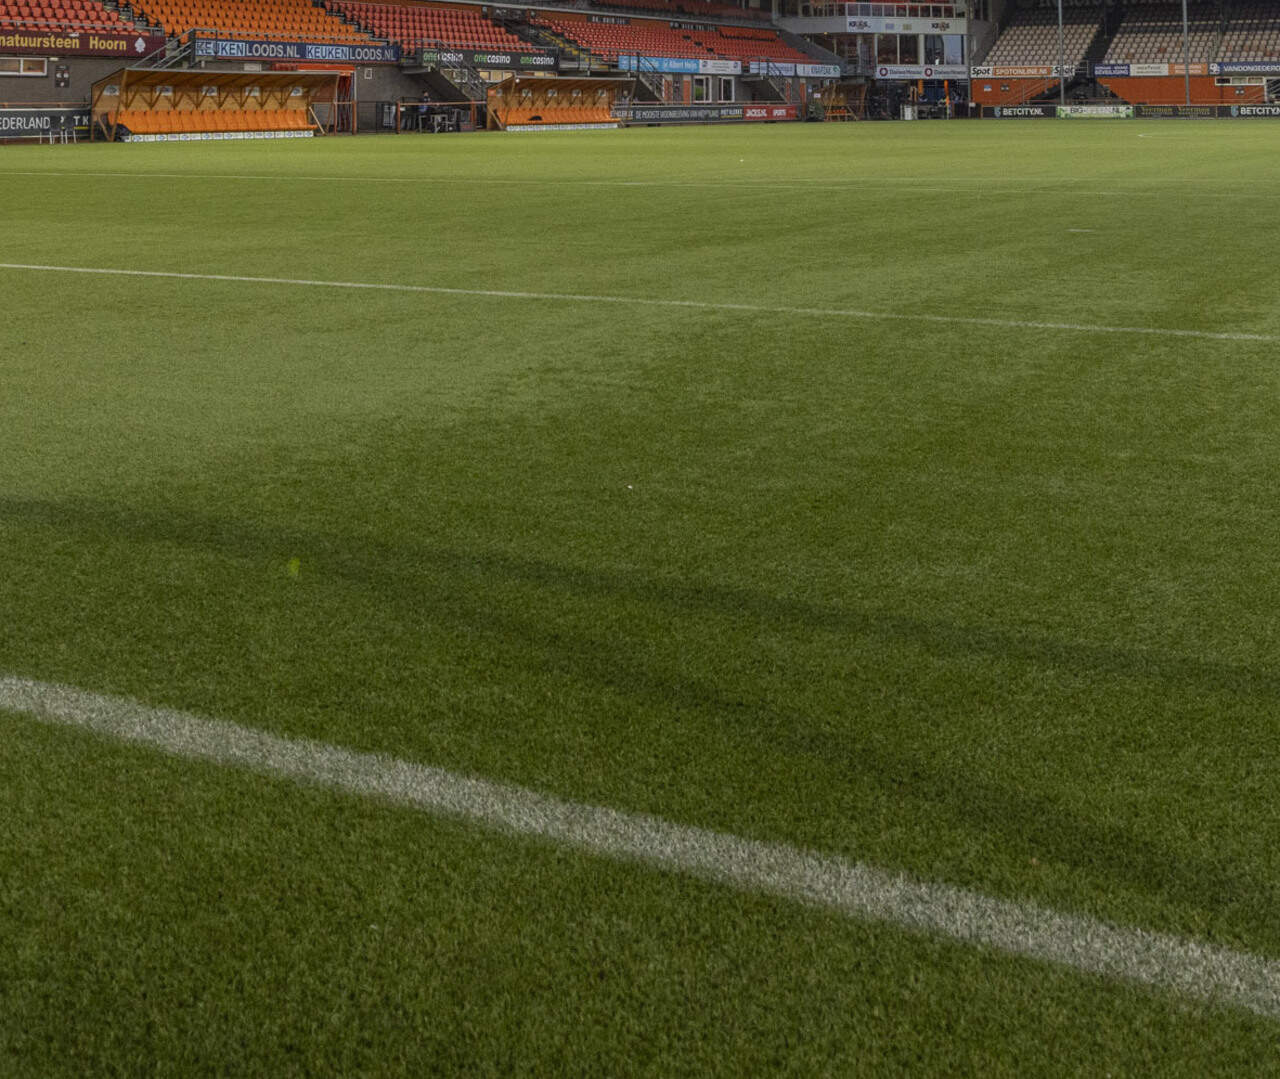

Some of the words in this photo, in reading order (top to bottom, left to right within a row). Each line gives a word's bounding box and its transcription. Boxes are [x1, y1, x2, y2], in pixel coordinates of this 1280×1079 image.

[89, 36, 127, 51] Hoorn
[306, 44, 396, 62] KEUKENLOODS.NL
[972, 68, 991, 77] Spot
